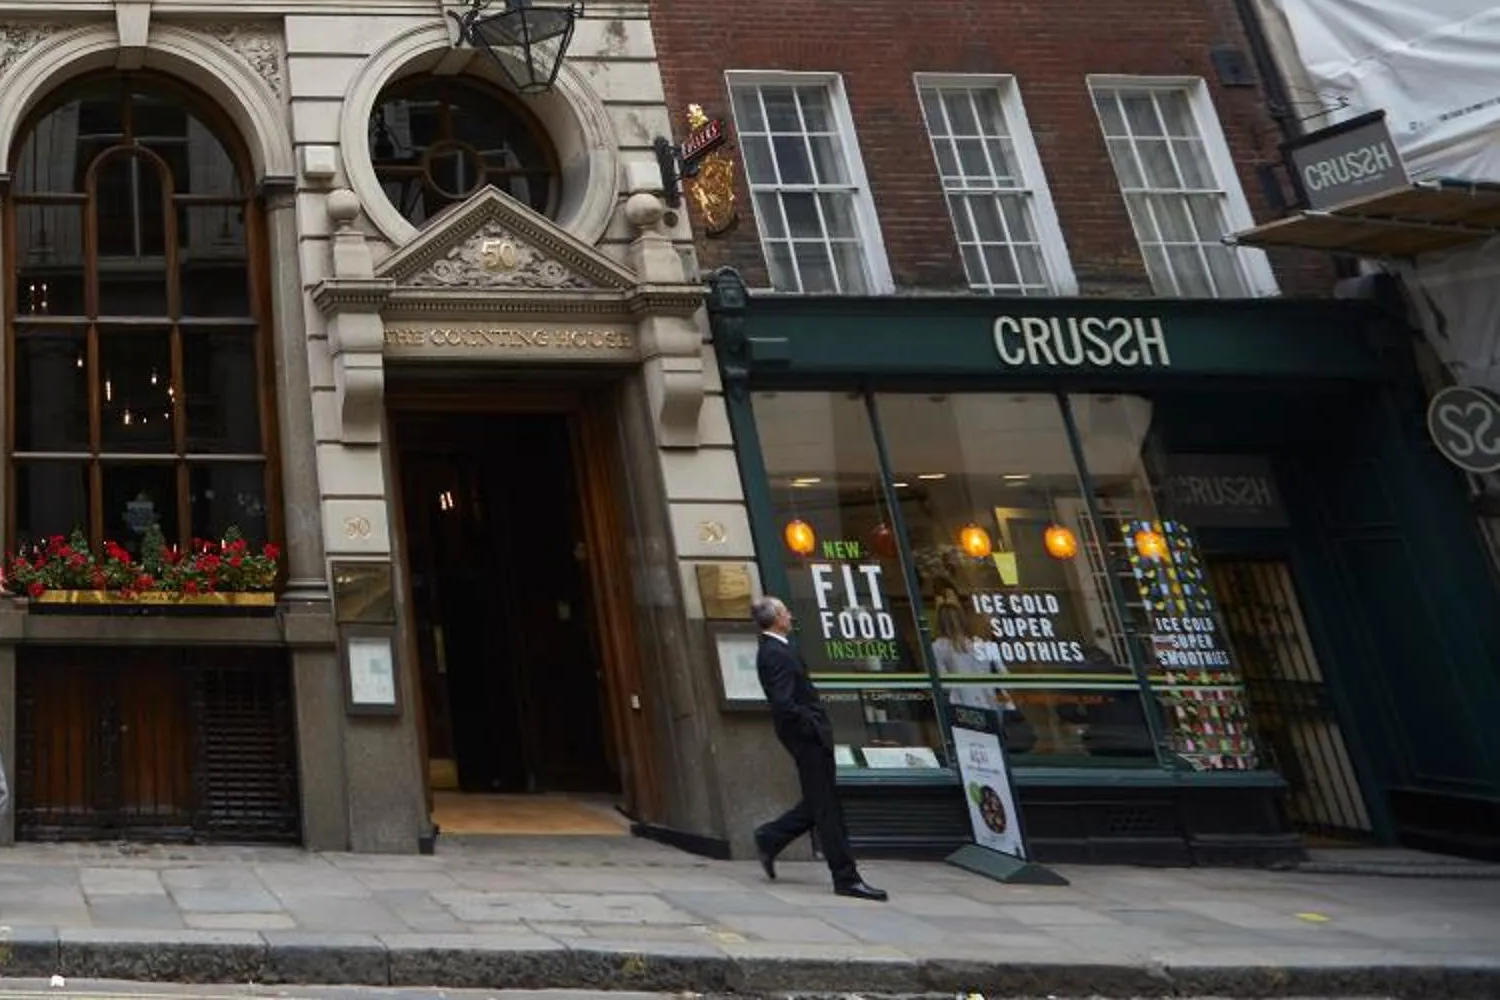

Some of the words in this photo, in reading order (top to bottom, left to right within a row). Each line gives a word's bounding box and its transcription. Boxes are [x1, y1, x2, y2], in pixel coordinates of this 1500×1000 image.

[1304, 141, 1394, 191] CRUSSH
[482, 240, 516, 272] 50
[383, 329, 425, 345] THE
[429, 329, 550, 348] COUNTING
[555, 330, 633, 349] HOUSE
[993, 315, 1171, 366] CRUSSH
[344, 517, 371, 539] 50
[823, 541, 860, 559] NEW
[810, 563, 883, 609] FIT
[972, 594, 1007, 614] ICE
[1011, 594, 1060, 615] COLD
[820, 611, 895, 639] FOOD
[990, 617, 1055, 638] SUPER
[1155, 617, 1180, 632] ICE
[1182, 617, 1215, 633] COLD
[826, 641, 900, 660] INSTORE
[1172, 634, 1215, 649] SUPER
[973, 641, 1085, 664] SMOOTHIES
[1159, 650, 1230, 666] SMOOTHIES
